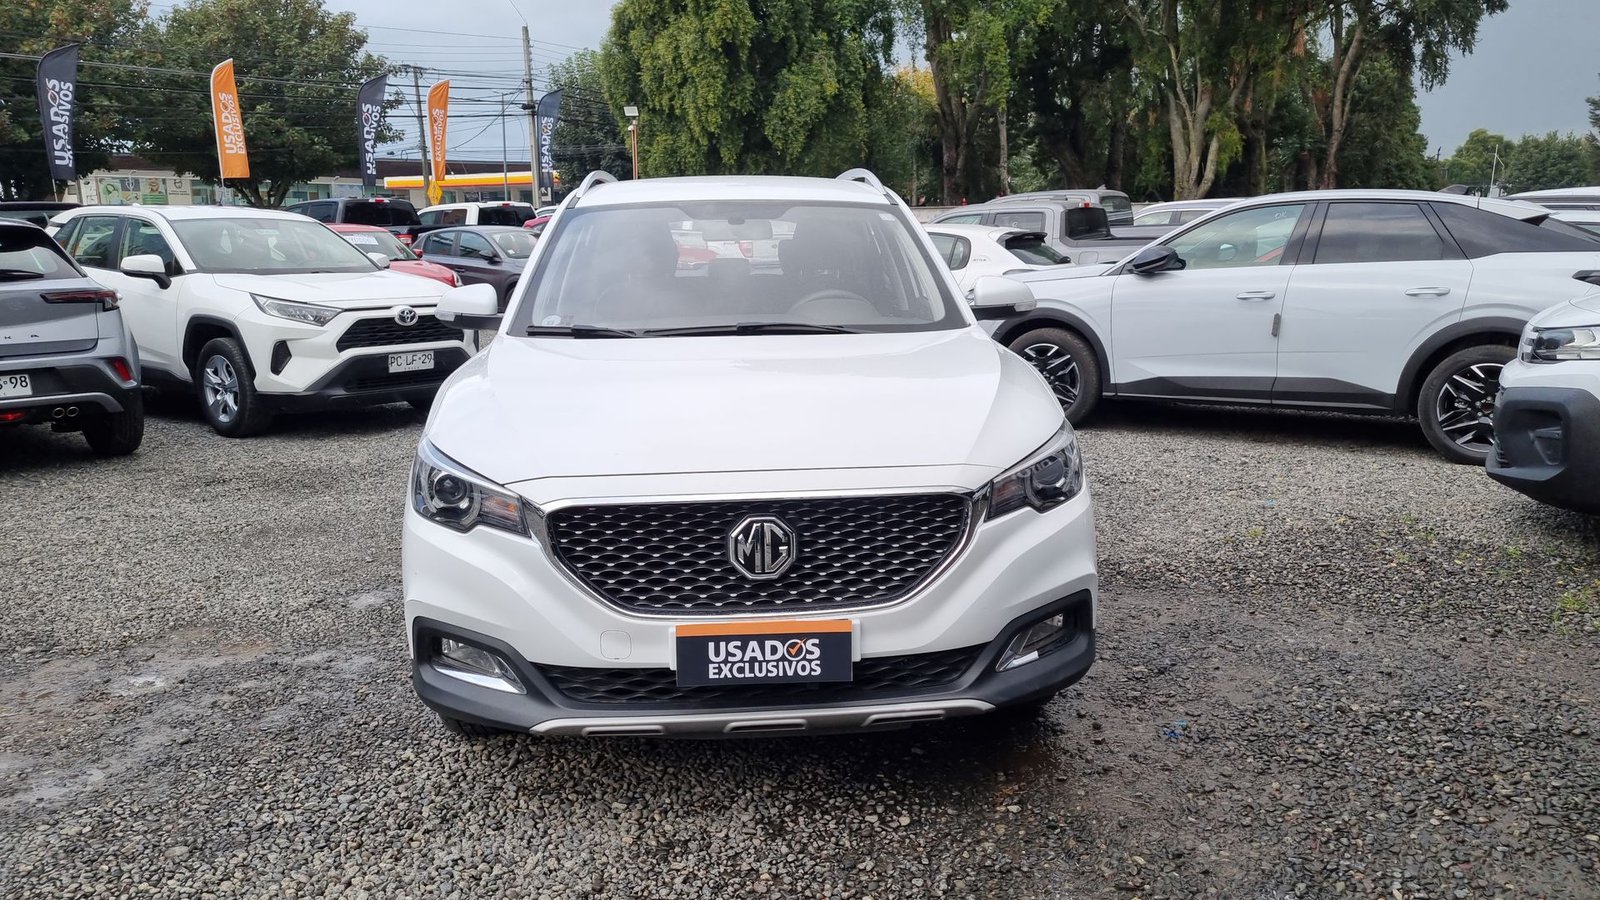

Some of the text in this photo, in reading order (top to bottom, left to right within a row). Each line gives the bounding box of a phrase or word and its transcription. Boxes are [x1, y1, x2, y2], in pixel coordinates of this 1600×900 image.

[46, 78, 70, 166] USADOS
[218, 92, 237, 154] USADOS
[227, 94, 245, 154] EXCLUSIVOS
[362, 103, 374, 175] USADOS
[541, 116, 549, 173] USADOS
[737, 522, 789, 573] MG
[708, 638, 821, 662] USADOS
[708, 660, 821, 679] EXCLUSIVOS
